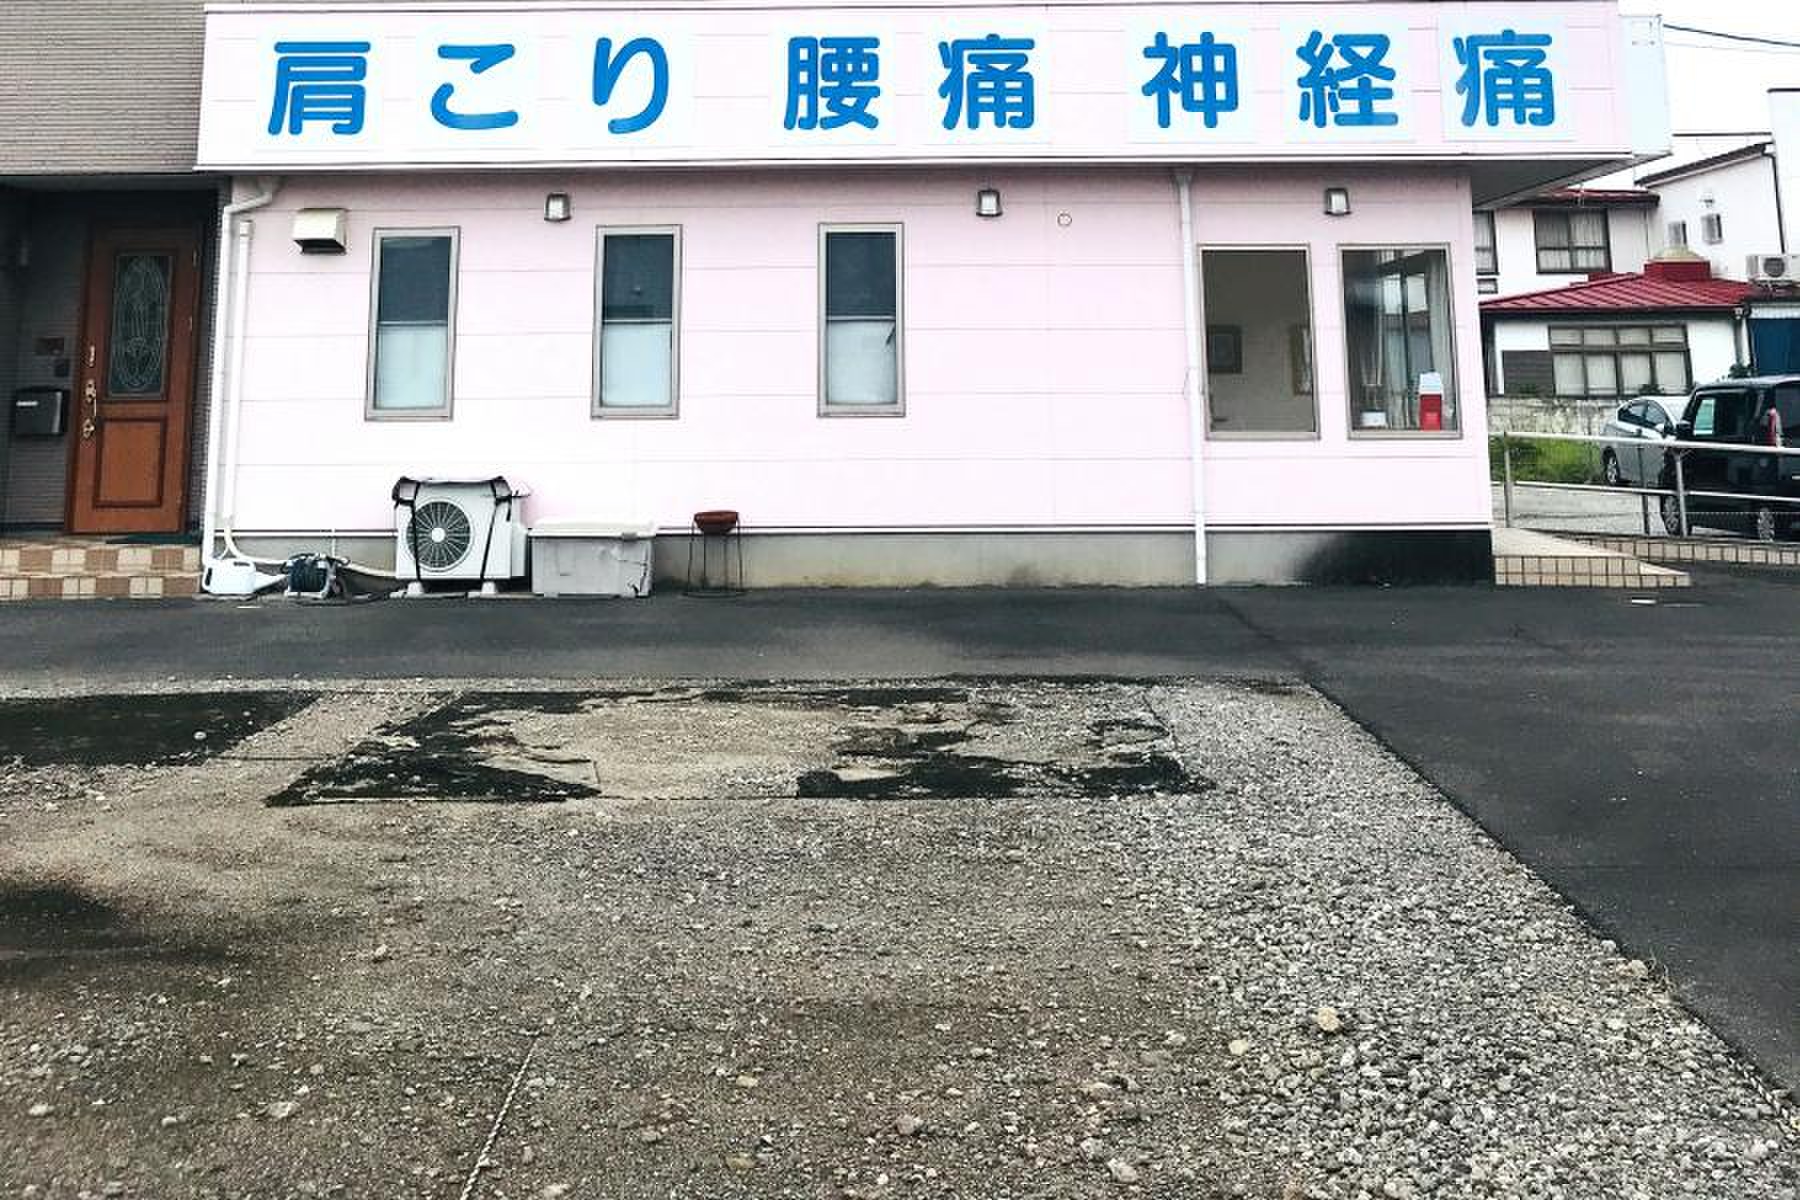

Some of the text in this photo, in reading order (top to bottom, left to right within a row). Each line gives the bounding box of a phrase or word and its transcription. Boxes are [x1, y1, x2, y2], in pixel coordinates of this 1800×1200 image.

[266, 27, 1558, 137] 肩こり 腰痛 神経痛
